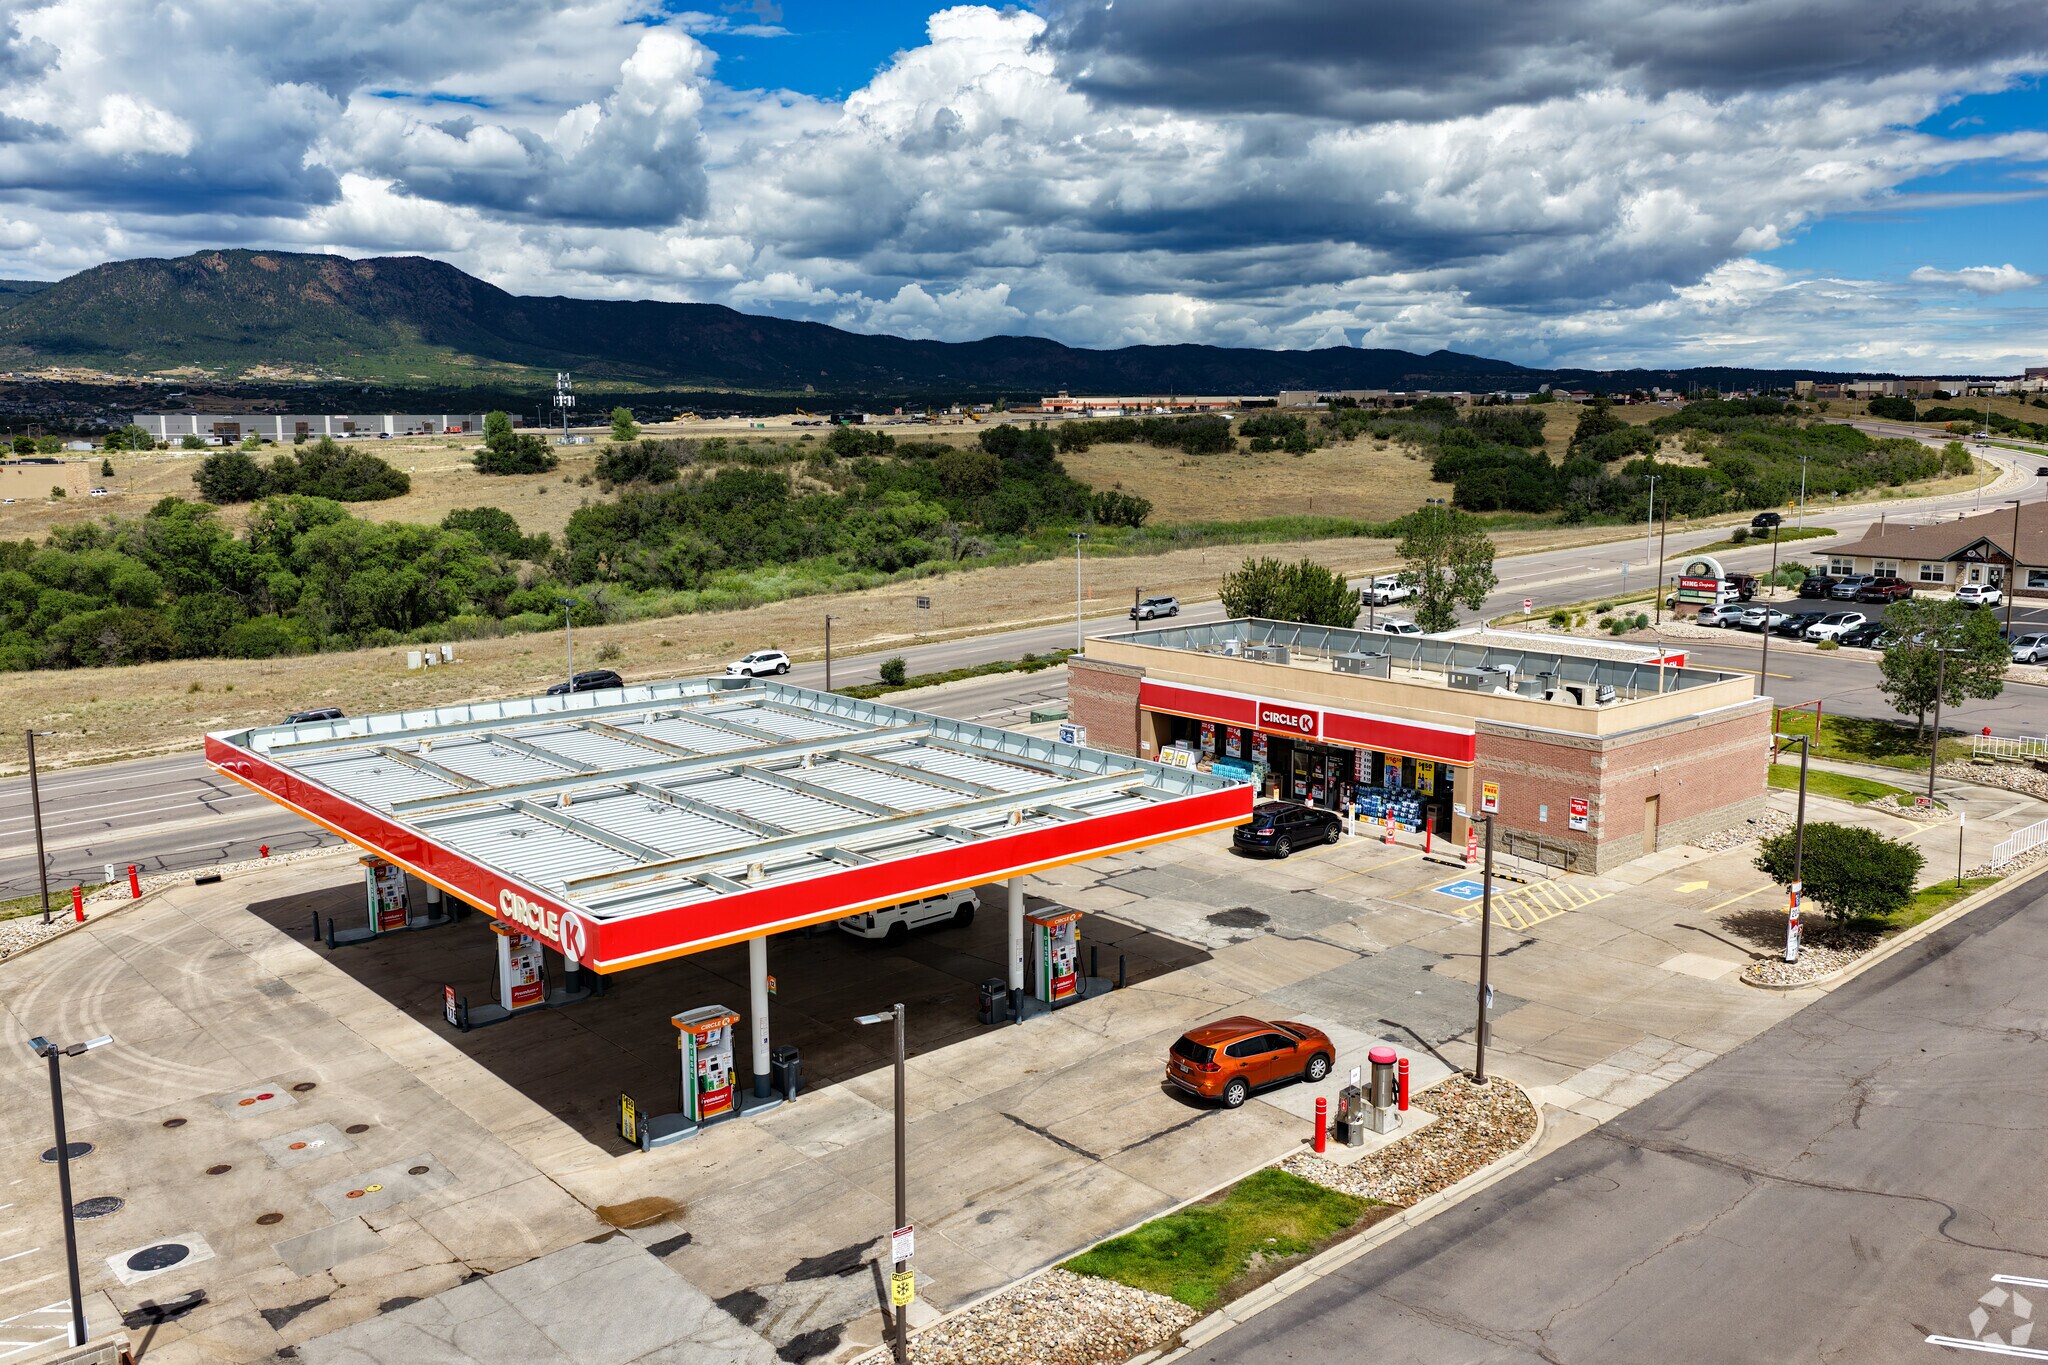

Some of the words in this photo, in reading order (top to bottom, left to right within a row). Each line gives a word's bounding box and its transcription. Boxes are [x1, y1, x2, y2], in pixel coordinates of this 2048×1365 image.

[1262, 711, 1298, 726] CIRCLE
[1299, 714, 1313, 732] K
[499, 889, 559, 942] CIRCLE
[561, 911, 585, 962] K
[701, 1020, 721, 1031] CIRCLE
[722, 1017, 730, 1026] K
[892, 1271, 914, 1281] CAUTION
